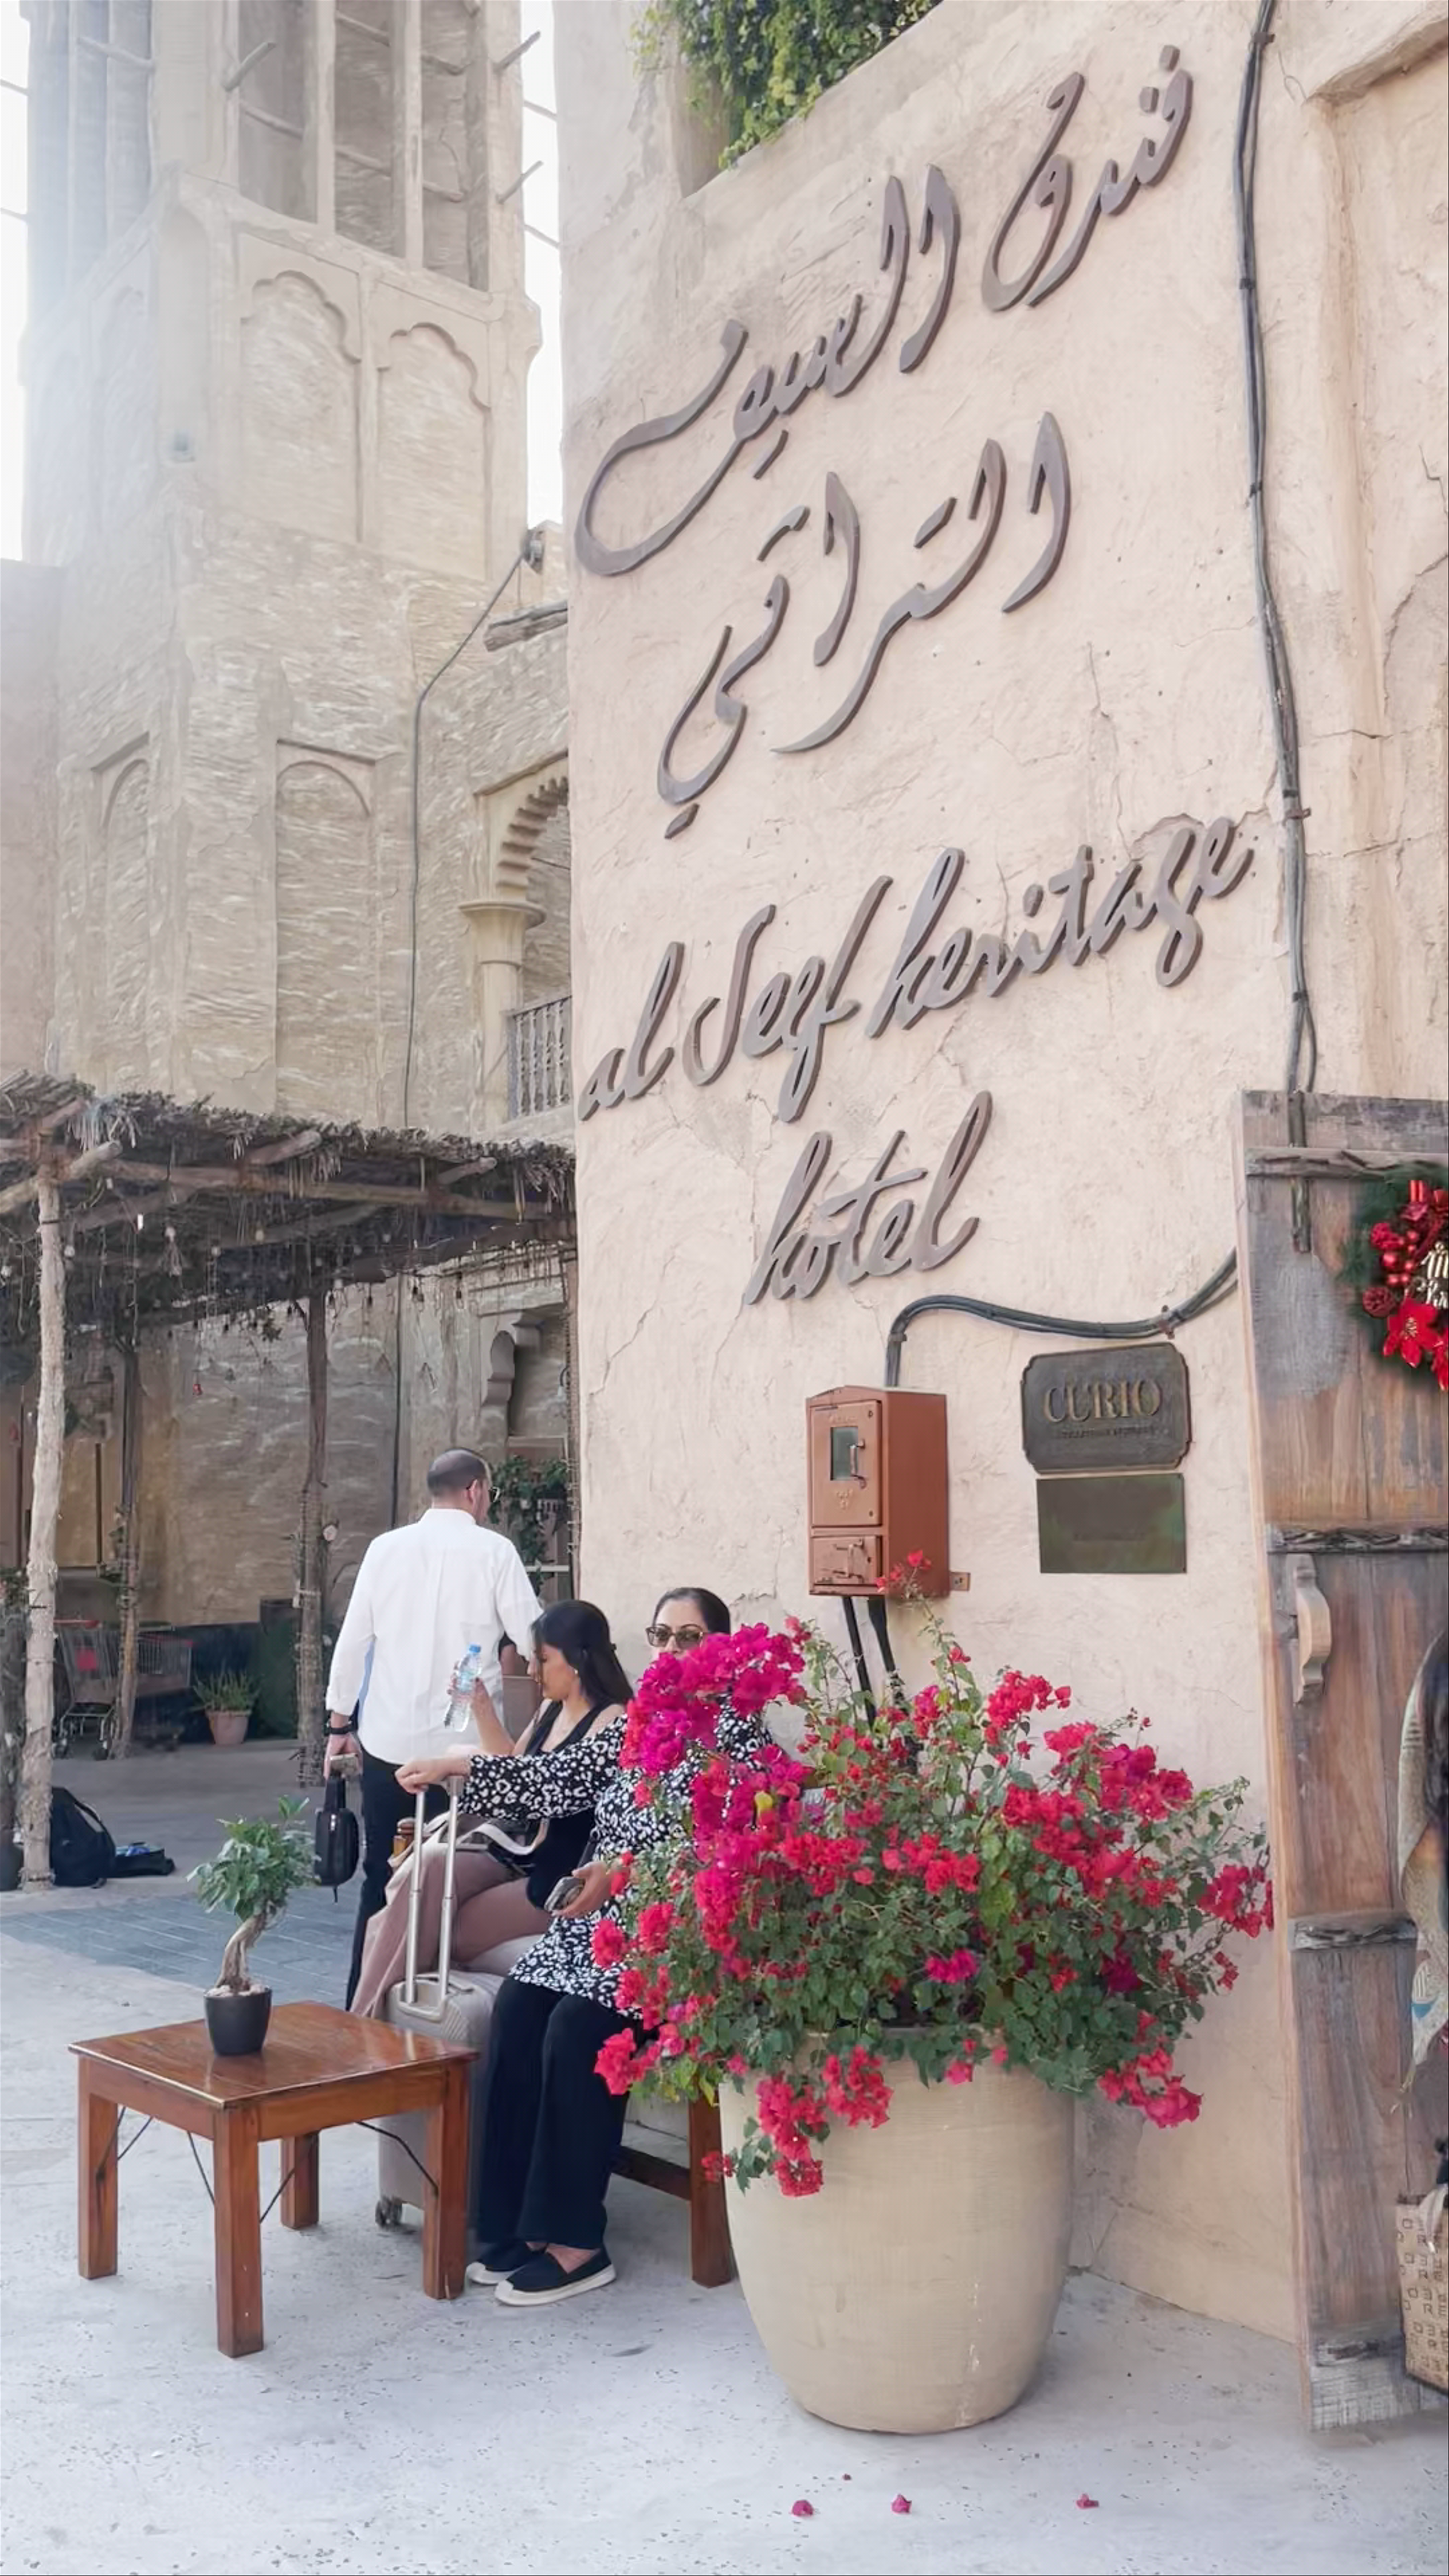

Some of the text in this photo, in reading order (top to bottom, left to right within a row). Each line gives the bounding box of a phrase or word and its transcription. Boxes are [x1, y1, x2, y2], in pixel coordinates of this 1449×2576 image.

[574, 44, 1192, 576] فندق السيف
[866, 817, 1254, 1038] heritage
[744, 1090, 992, 1305] hotel
[1043, 1379, 1163, 1422] CURIO
